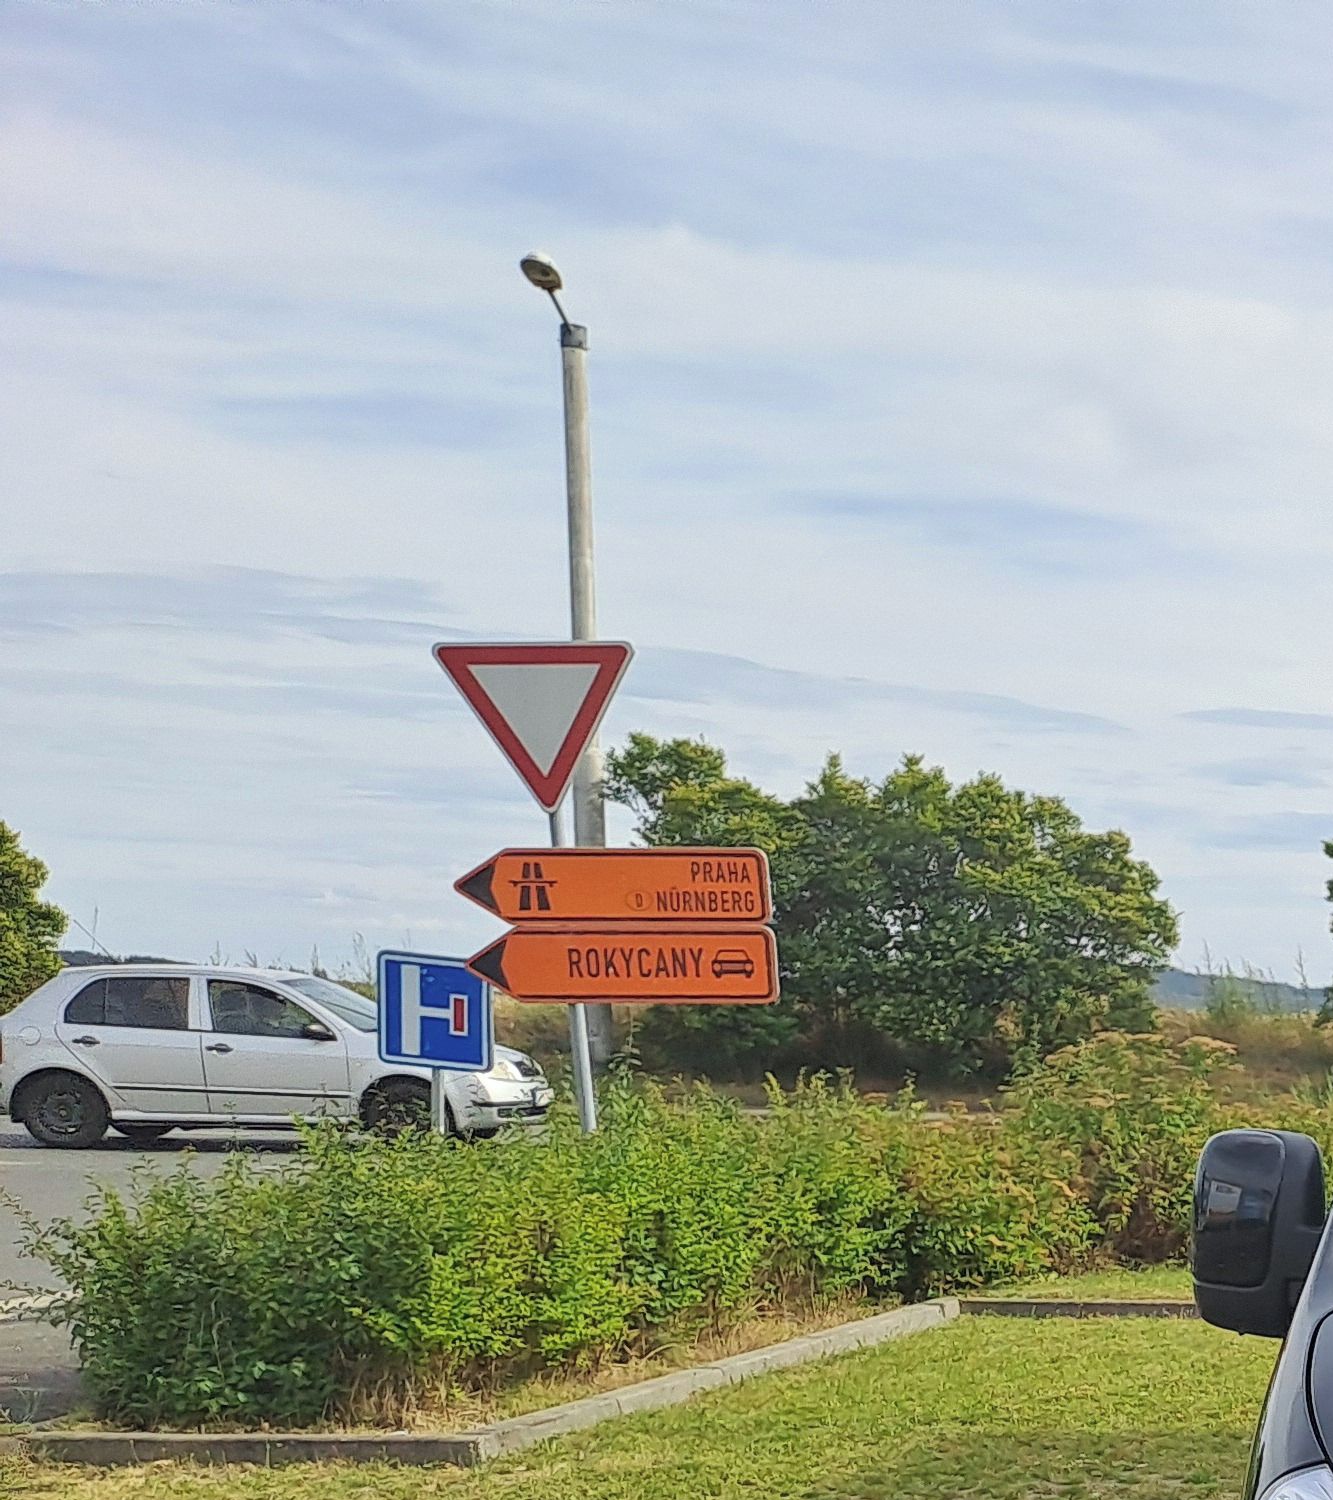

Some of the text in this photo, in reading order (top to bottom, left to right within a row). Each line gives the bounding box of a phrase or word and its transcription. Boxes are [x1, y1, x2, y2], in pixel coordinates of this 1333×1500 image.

[691, 861, 751, 883] PRAHA
[635, 887, 755, 913] D NÜRNBERG
[568, 948, 703, 979] ROKYCANY
